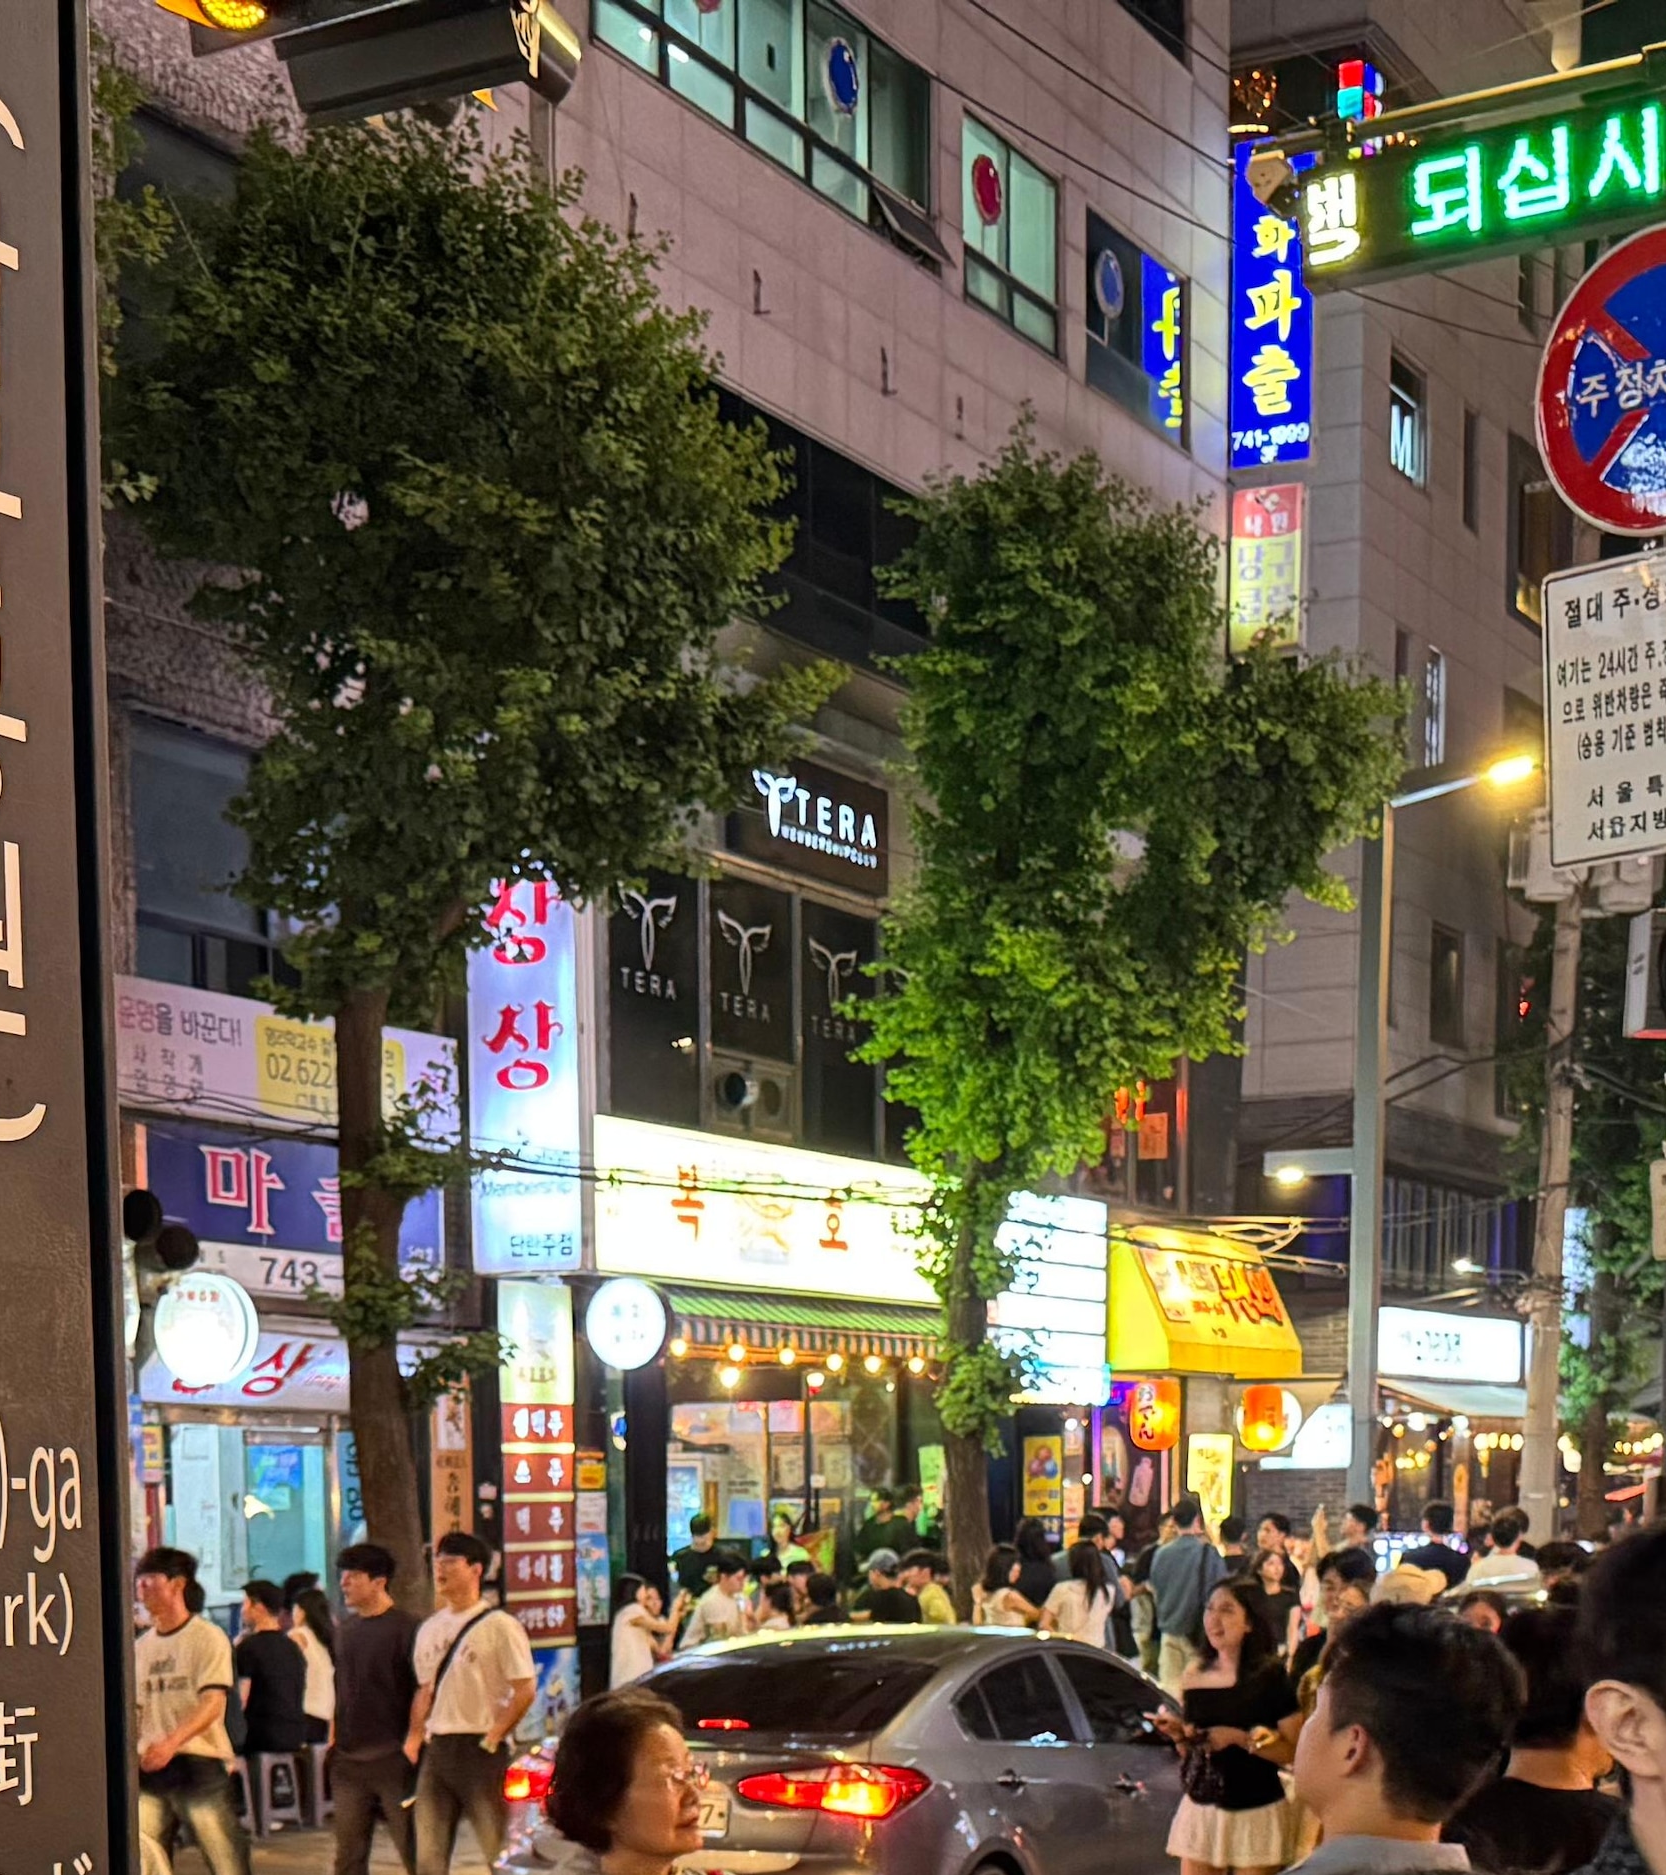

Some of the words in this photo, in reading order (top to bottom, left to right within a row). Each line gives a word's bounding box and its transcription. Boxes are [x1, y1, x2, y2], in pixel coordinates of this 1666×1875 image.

[1412, 107, 1659, 235] 되십시
[1564, 591, 1603, 629] 절대
[1598, 643, 1639, 680] 24시간
[1562, 698, 1586, 725] 으로
[794, 787, 877, 849] TERA
[620, 966, 677, 1001] TERA
[720, 991, 771, 1023] TERA
[811, 1015, 856, 1043] TERA
[510, 1232, 573, 1258] 단란주점
